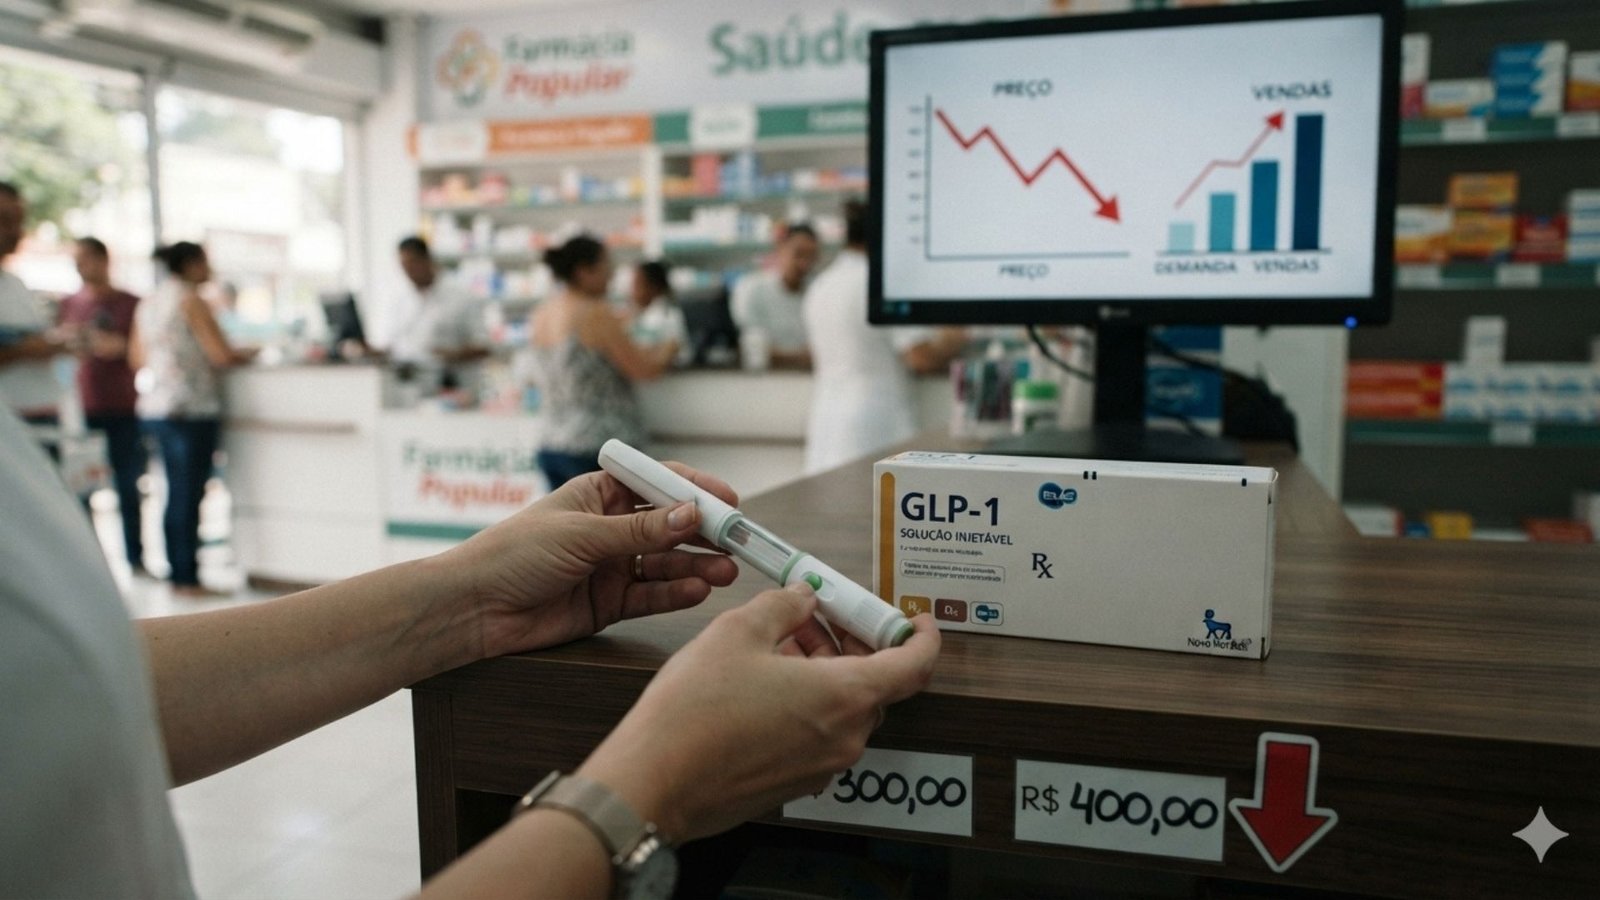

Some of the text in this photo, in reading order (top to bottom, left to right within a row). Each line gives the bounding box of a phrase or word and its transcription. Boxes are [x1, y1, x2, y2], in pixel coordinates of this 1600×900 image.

[992, 79, 1053, 99] PREÇO
[1251, 79, 1332, 100] VENDAS
[998, 263, 1048, 280] PREÇO
[1154, 258, 1320, 274] DEMANDA VENDAS
[900, 492, 999, 526] GLP-1
[833, 768, 967, 815] 300,00
[1021, 781, 1219, 836] R$ 400,00
